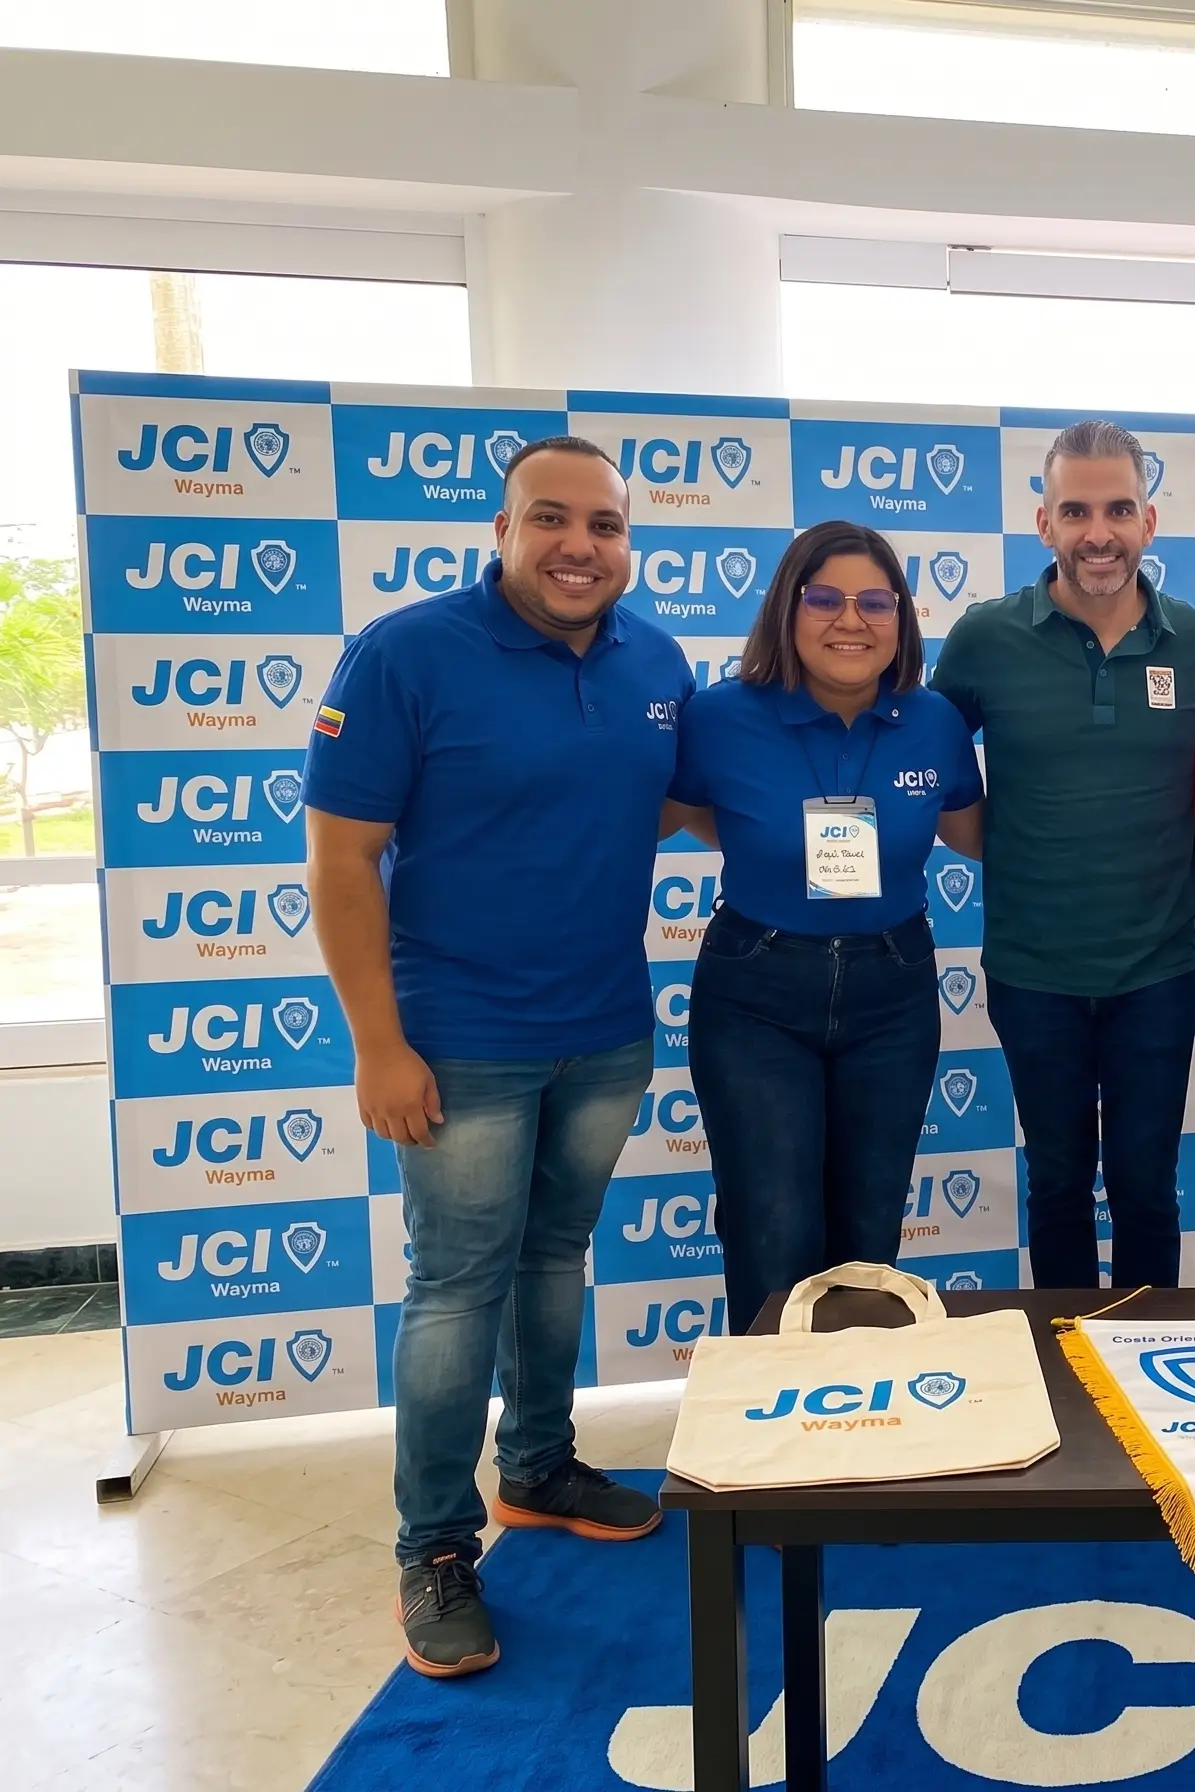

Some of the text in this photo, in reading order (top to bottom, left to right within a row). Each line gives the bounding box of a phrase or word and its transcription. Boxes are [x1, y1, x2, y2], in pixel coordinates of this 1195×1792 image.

[117, 424, 232, 473] JCI
[367, 431, 476, 479] JCI
[820, 445, 918, 491] JCI
[175, 478, 244, 497] Wayma
[423, 485, 487, 503] Wayma
[649, 490, 711, 508] Wayma
[870, 495, 927, 514] Wayma
[125, 543, 241, 590] JCI
[373, 546, 480, 593] JCI
[183, 596, 252, 615] Wayma
[654, 600, 716, 619] Wayma
[132, 660, 246, 707] JCI
[187, 711, 257, 729] Wayma
[646, 702, 669, 720] JCI
[893, 771, 924, 788] JCI
[137, 775, 252, 824] JCI
[193, 827, 263, 845] Wayma
[820, 826, 848, 838] JCI
[142, 889, 258, 939] JCI
[197, 941, 267, 959] Wayma
[148, 1003, 264, 1054] JCI
[202, 1055, 272, 1074] Wayma
[152, 1115, 266, 1168] JCI
[205, 1167, 275, 1186] Wayma
[157, 1228, 271, 1281] JCI
[670, 1244, 724, 1260] Waym
[210, 1280, 281, 1298] Wayma
[626, 1296, 726, 1348] JCI
[1112, 1335, 1156, 1344] Costa
[163, 1338, 277, 1392] JCI
[216, 1388, 286, 1407] Wayma
[744, 1379, 894, 1422] JCI
[801, 1415, 902, 1433] Wayma
